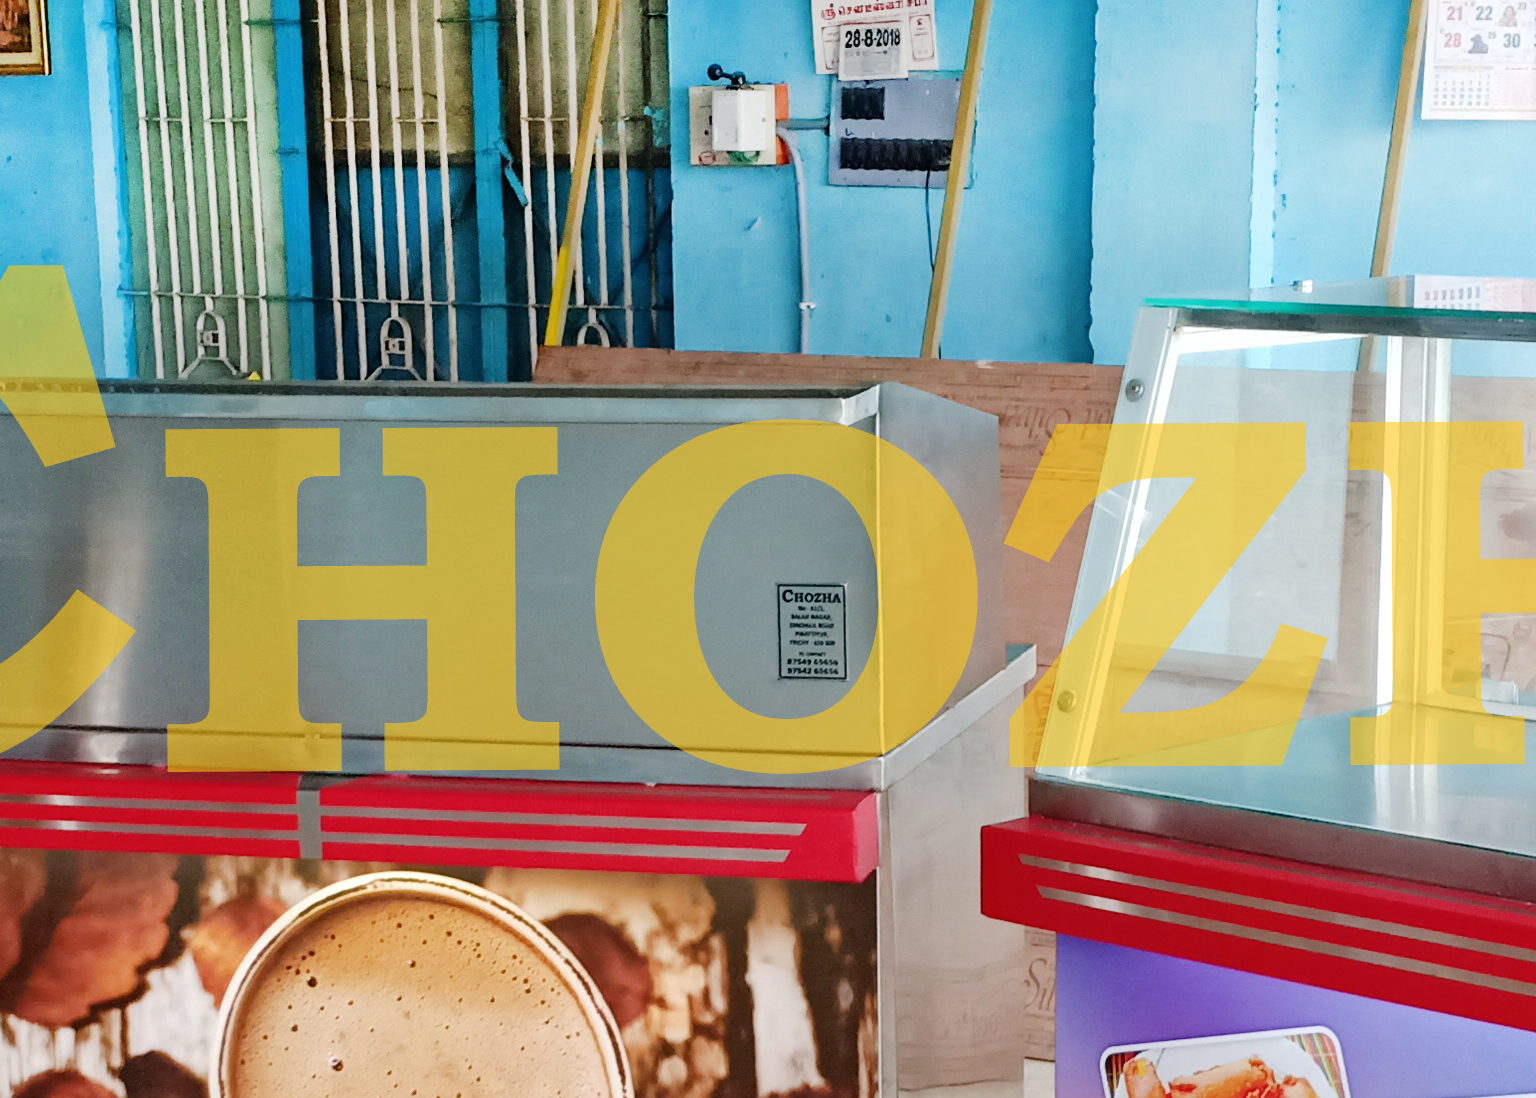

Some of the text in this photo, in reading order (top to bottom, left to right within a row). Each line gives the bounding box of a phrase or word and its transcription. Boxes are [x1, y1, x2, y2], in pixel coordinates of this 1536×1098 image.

[1446, 6, 1463, 21] 21
[1476, 6, 1493, 21] 22
[845, 28, 901, 48] 28-8-2018
[1444, 33, 1462, 48] 28
[1503, 33, 1521, 48] 30
